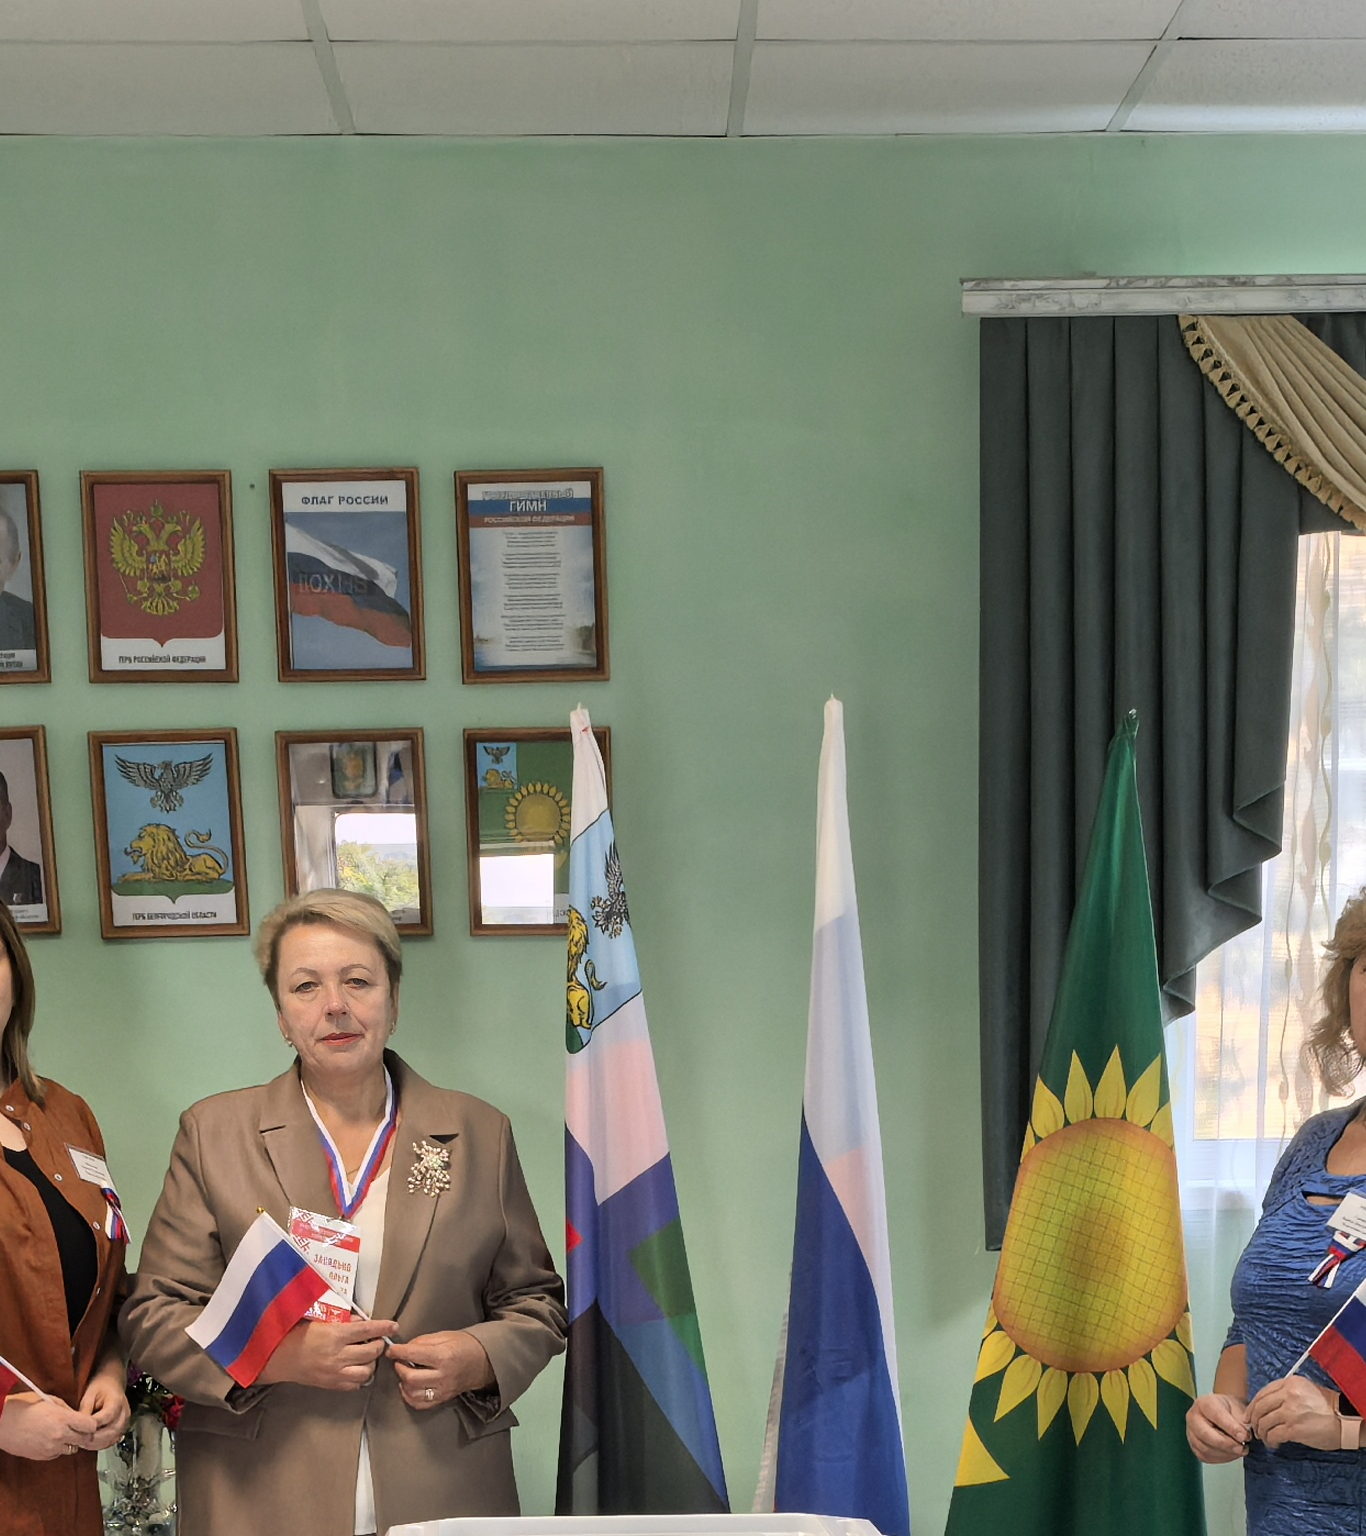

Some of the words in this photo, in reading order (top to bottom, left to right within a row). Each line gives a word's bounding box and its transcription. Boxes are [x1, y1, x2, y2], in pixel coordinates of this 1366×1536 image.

[301, 495, 334, 506] ФЛАГ
[338, 495, 389, 505] РОССИИ
[509, 500, 547, 512] ГИМН
